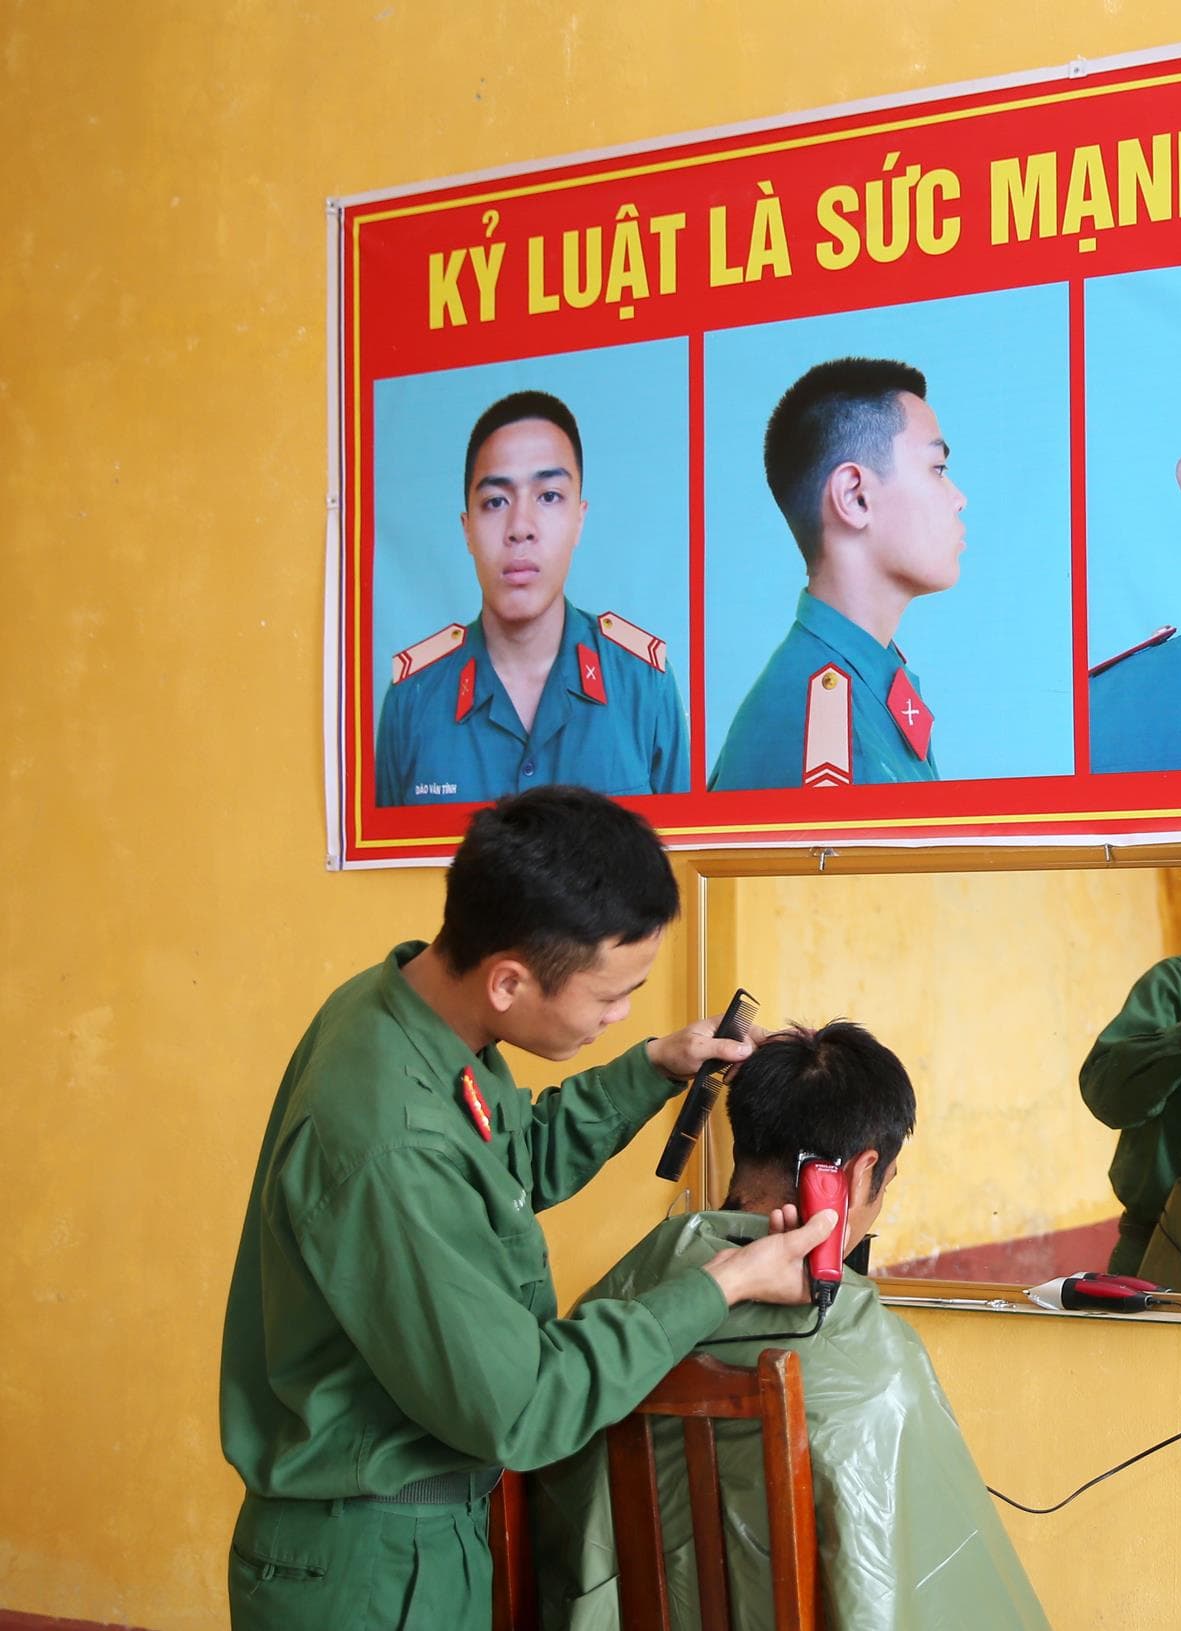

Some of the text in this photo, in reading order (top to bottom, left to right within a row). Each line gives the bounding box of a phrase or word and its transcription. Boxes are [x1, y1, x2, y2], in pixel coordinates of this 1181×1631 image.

[429, 210, 506, 329] KỶ
[528, 203, 686, 320] LUẬT
[709, 180, 792, 287] LÀ
[816, 151, 961, 270] SỨC
